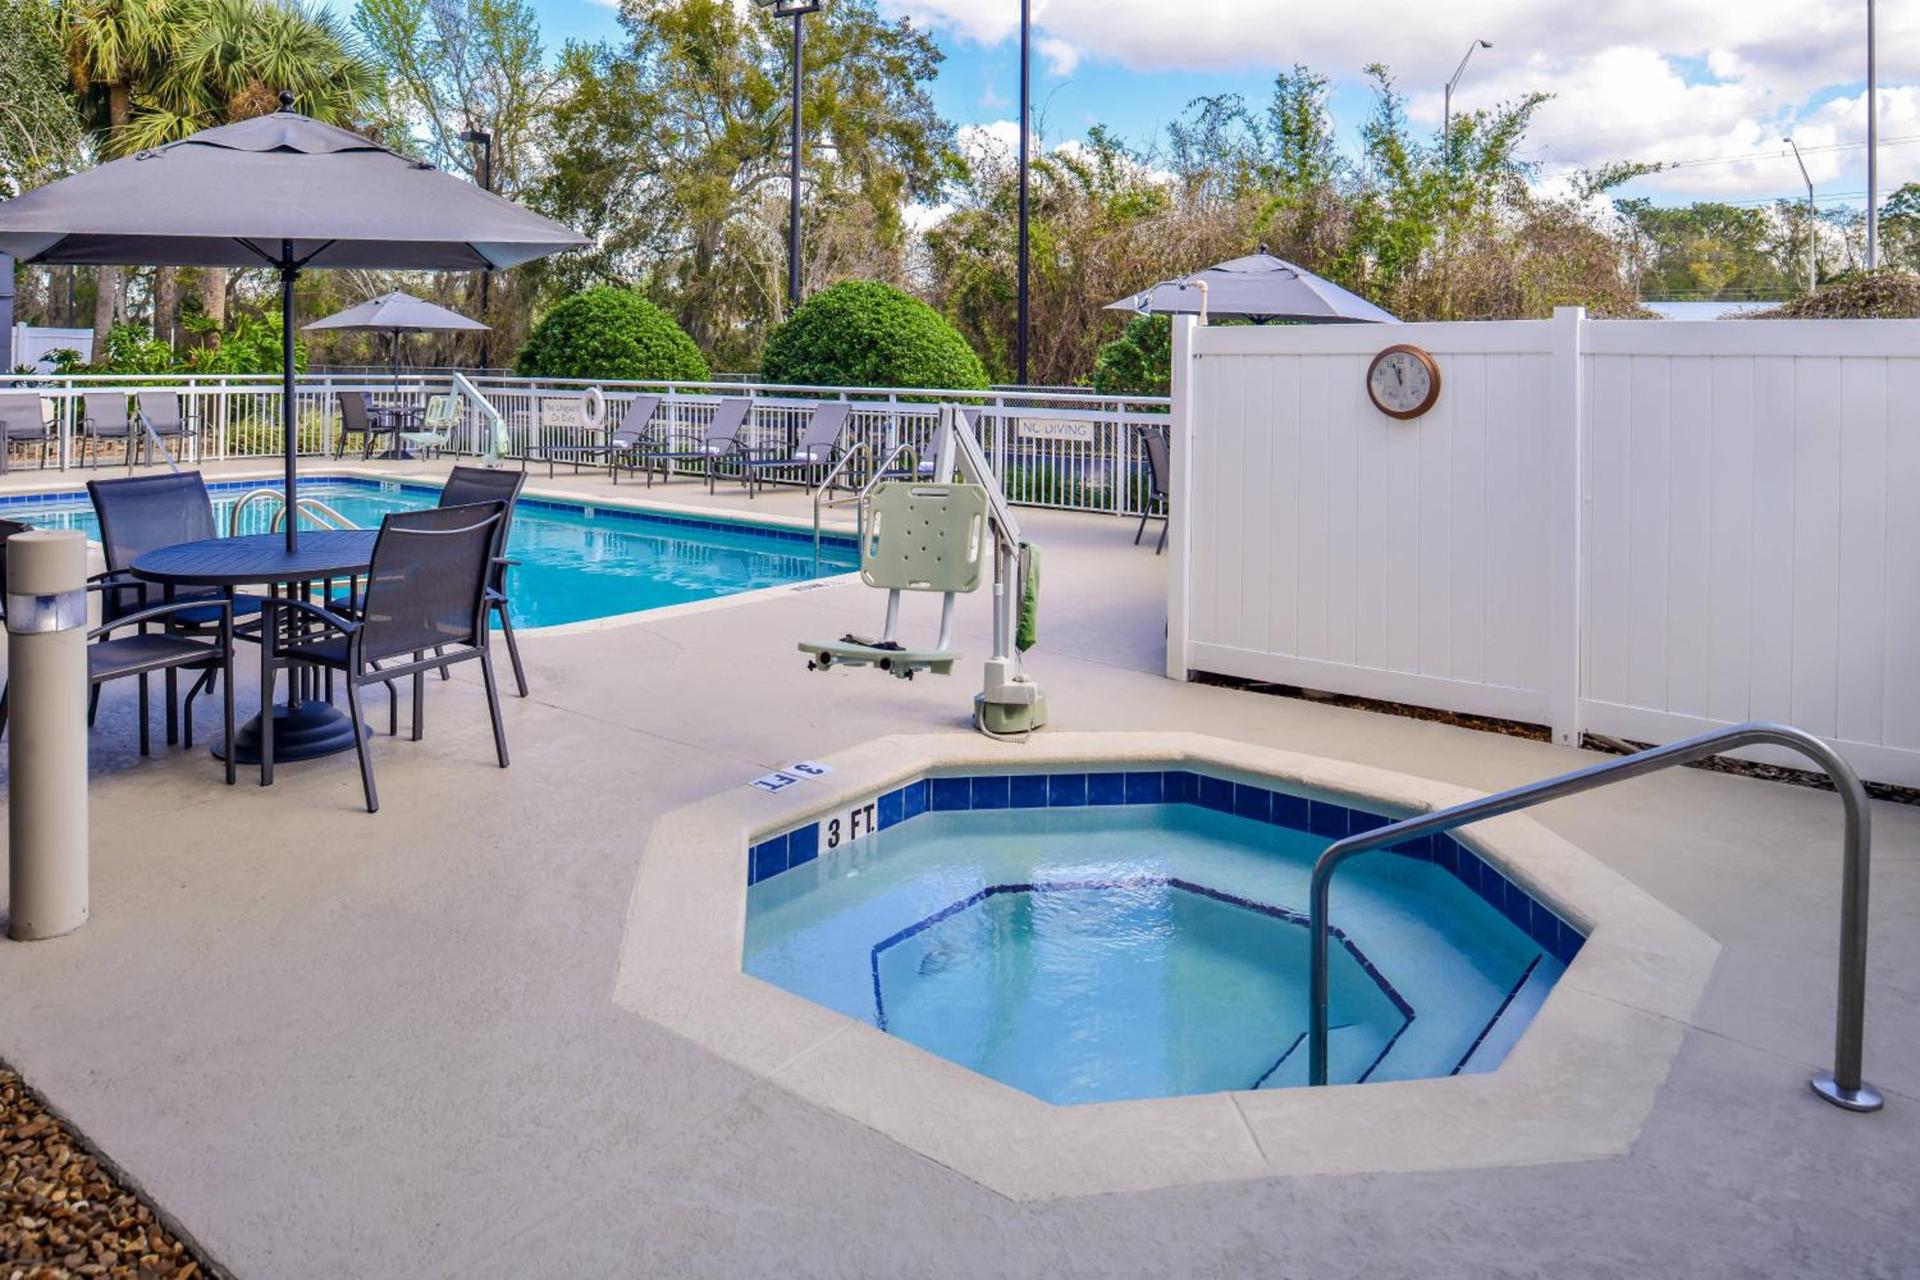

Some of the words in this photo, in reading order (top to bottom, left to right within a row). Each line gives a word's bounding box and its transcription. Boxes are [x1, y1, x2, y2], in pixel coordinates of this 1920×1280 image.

[1023, 422, 1040, 434] NO
[1045, 423, 1087, 436] DIVING
[794, 764, 824, 775] 3
[827, 818, 841, 849] 3
[850, 803, 875, 841] FT.
